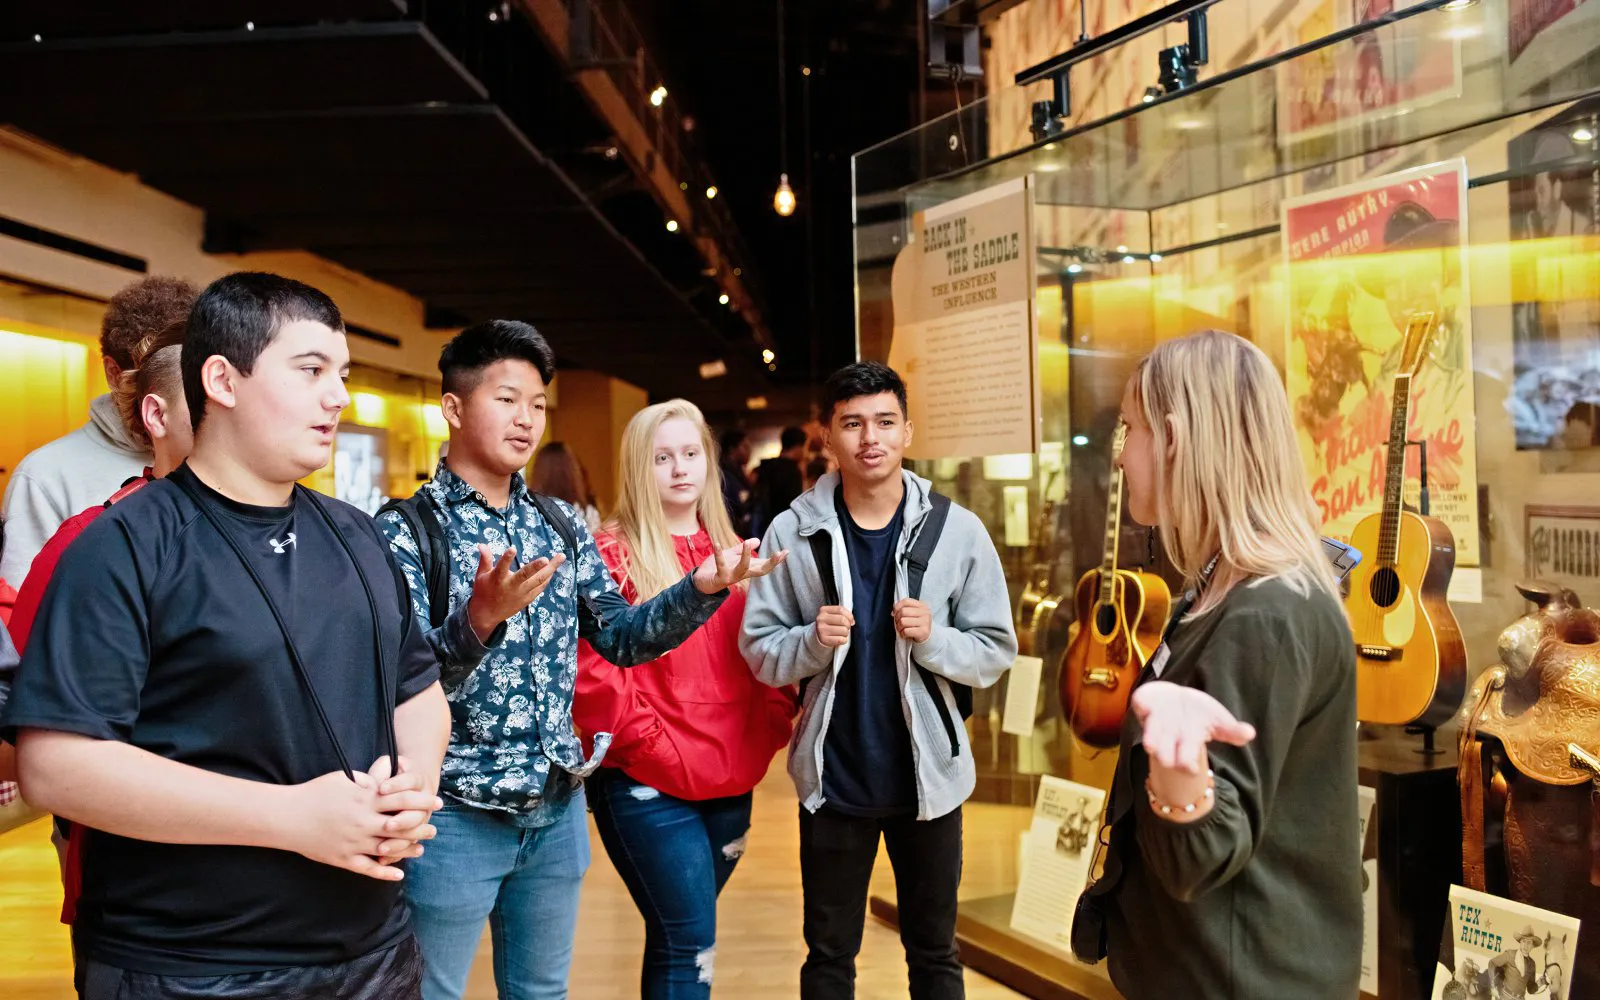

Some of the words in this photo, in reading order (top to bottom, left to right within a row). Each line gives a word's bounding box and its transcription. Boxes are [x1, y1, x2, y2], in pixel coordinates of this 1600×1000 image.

[924, 222, 951, 254] BACK
[954, 217, 967, 245] IN
[1292, 225, 1330, 259] GENE
[1336, 190, 1388, 233] AUTRY
[946, 247, 968, 276] THE
[973, 232, 1019, 269] SADDLE
[931, 282, 949, 298] THE
[951, 271, 997, 292] WESTERN
[943, 287, 998, 310] INFLUENCE
[1311, 476, 1364, 524] San
[1459, 904, 1481, 925] TEX
[1460, 925, 1502, 952] RITTER
